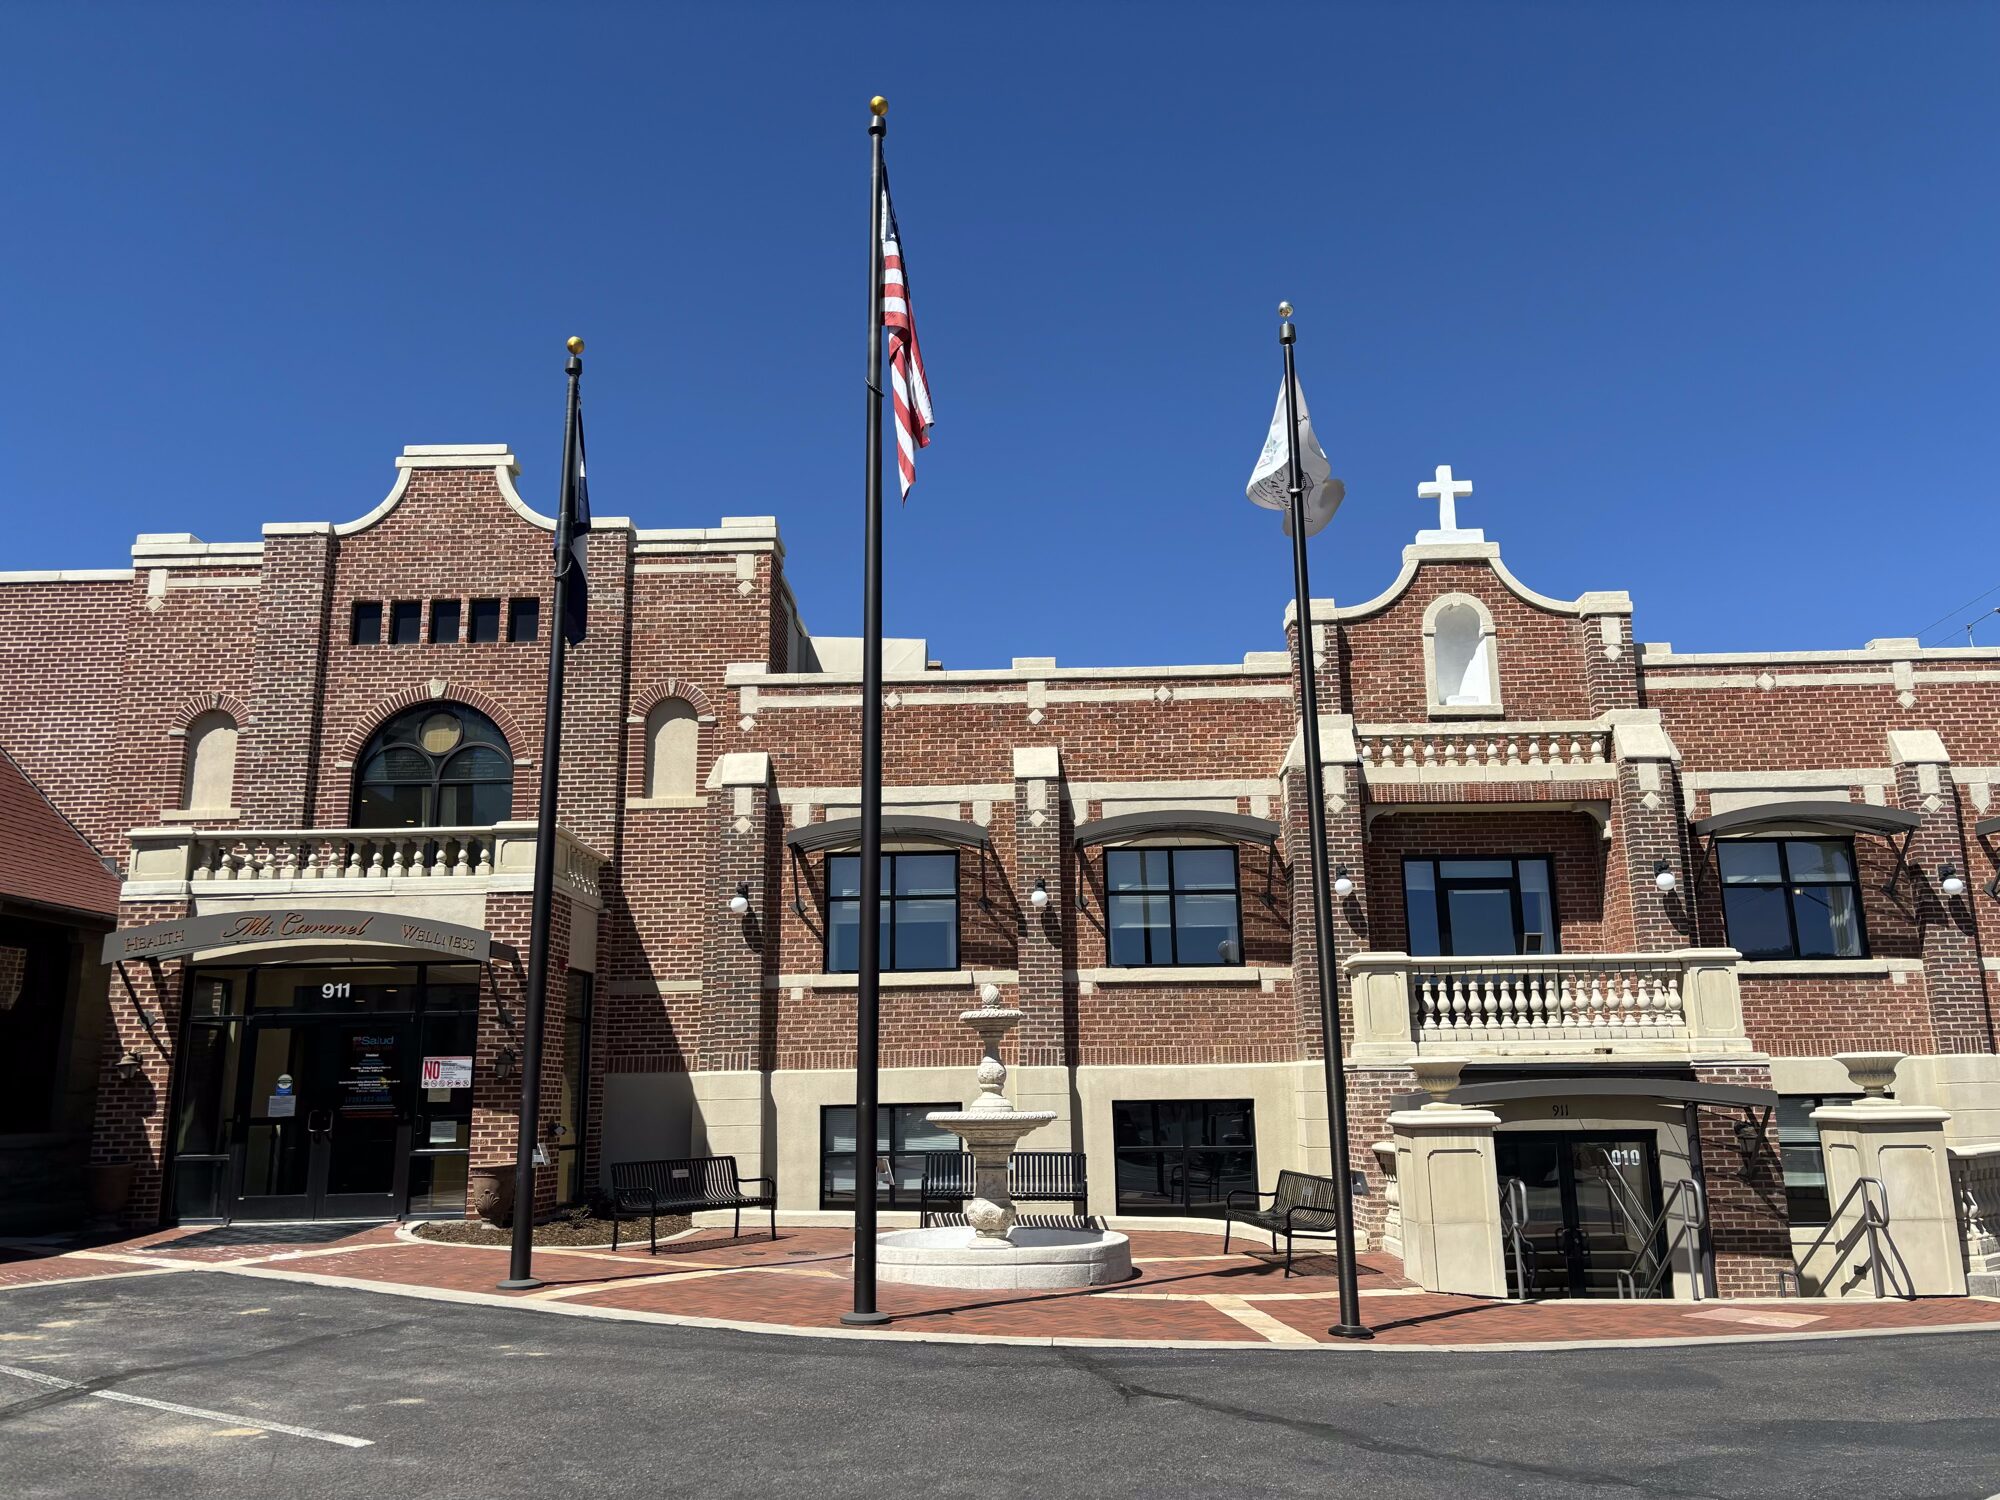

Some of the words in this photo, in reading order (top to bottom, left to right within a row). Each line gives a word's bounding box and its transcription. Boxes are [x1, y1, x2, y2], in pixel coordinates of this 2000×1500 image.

[125, 929, 185, 952] HEALTH
[280, 912, 374, 936] Carmel
[321, 982, 351, 999] 911
[361, 1036, 395, 1045] Salud
[423, 1060, 441, 1080] NO
[1552, 1104, 1569, 1117] 911
